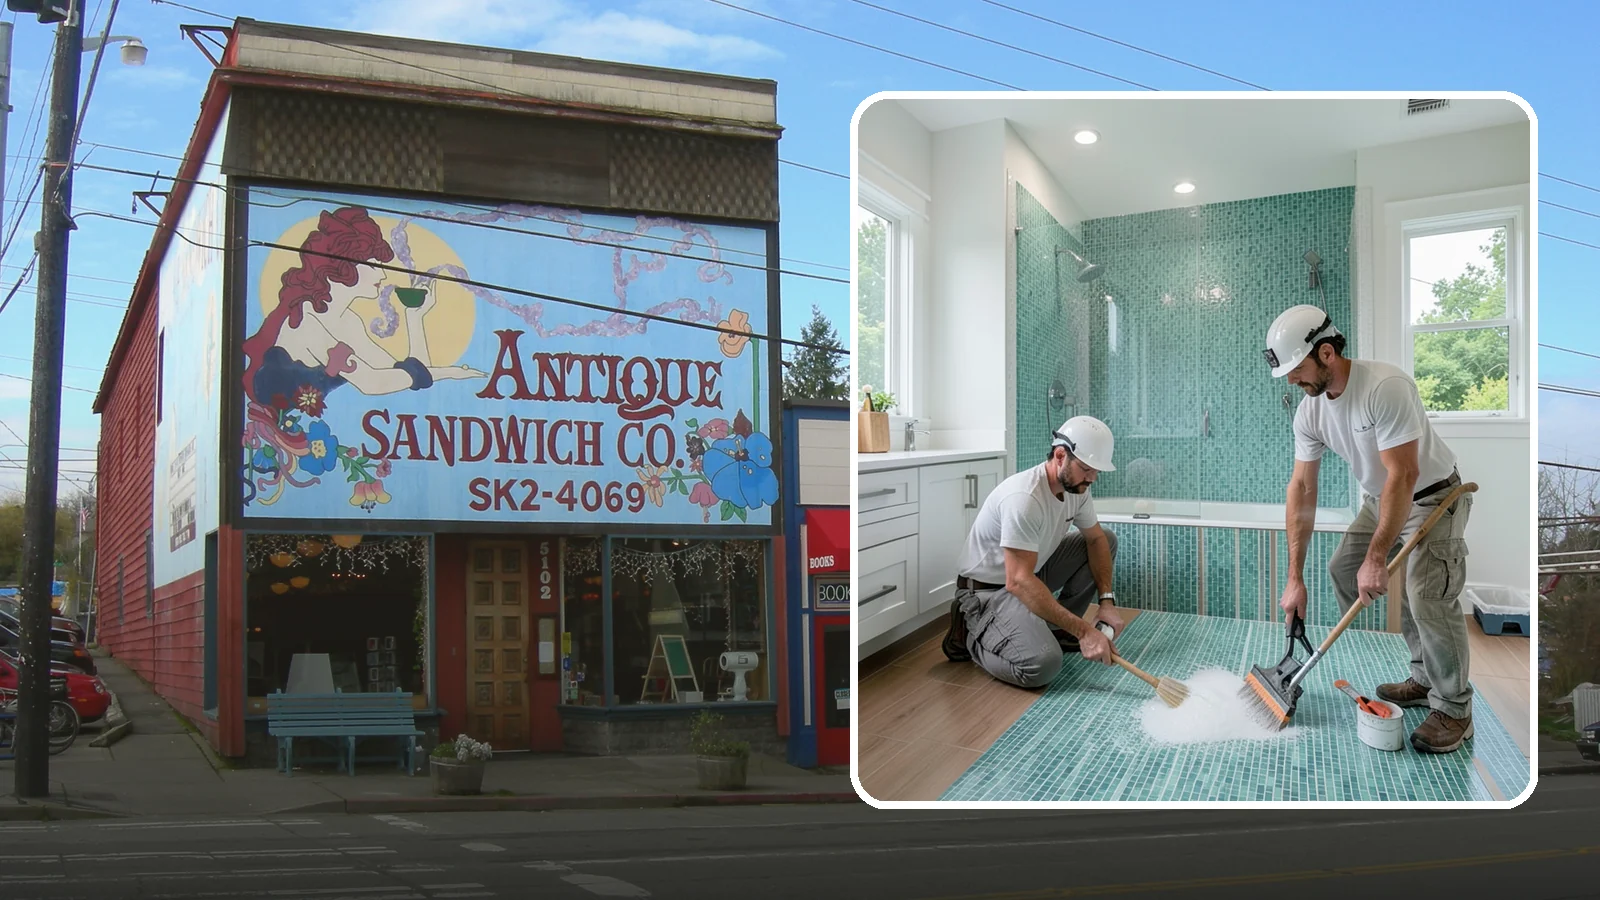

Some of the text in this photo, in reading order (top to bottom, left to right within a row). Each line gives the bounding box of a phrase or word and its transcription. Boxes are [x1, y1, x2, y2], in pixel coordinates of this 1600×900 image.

[476, 329, 723, 420] ANTIQUE
[361, 408, 685, 468] SANDWICH CO.
[468, 476, 645, 513] SK2-4069
[540, 541, 551, 599] 5102
[809, 555, 835, 569] BOOKS
